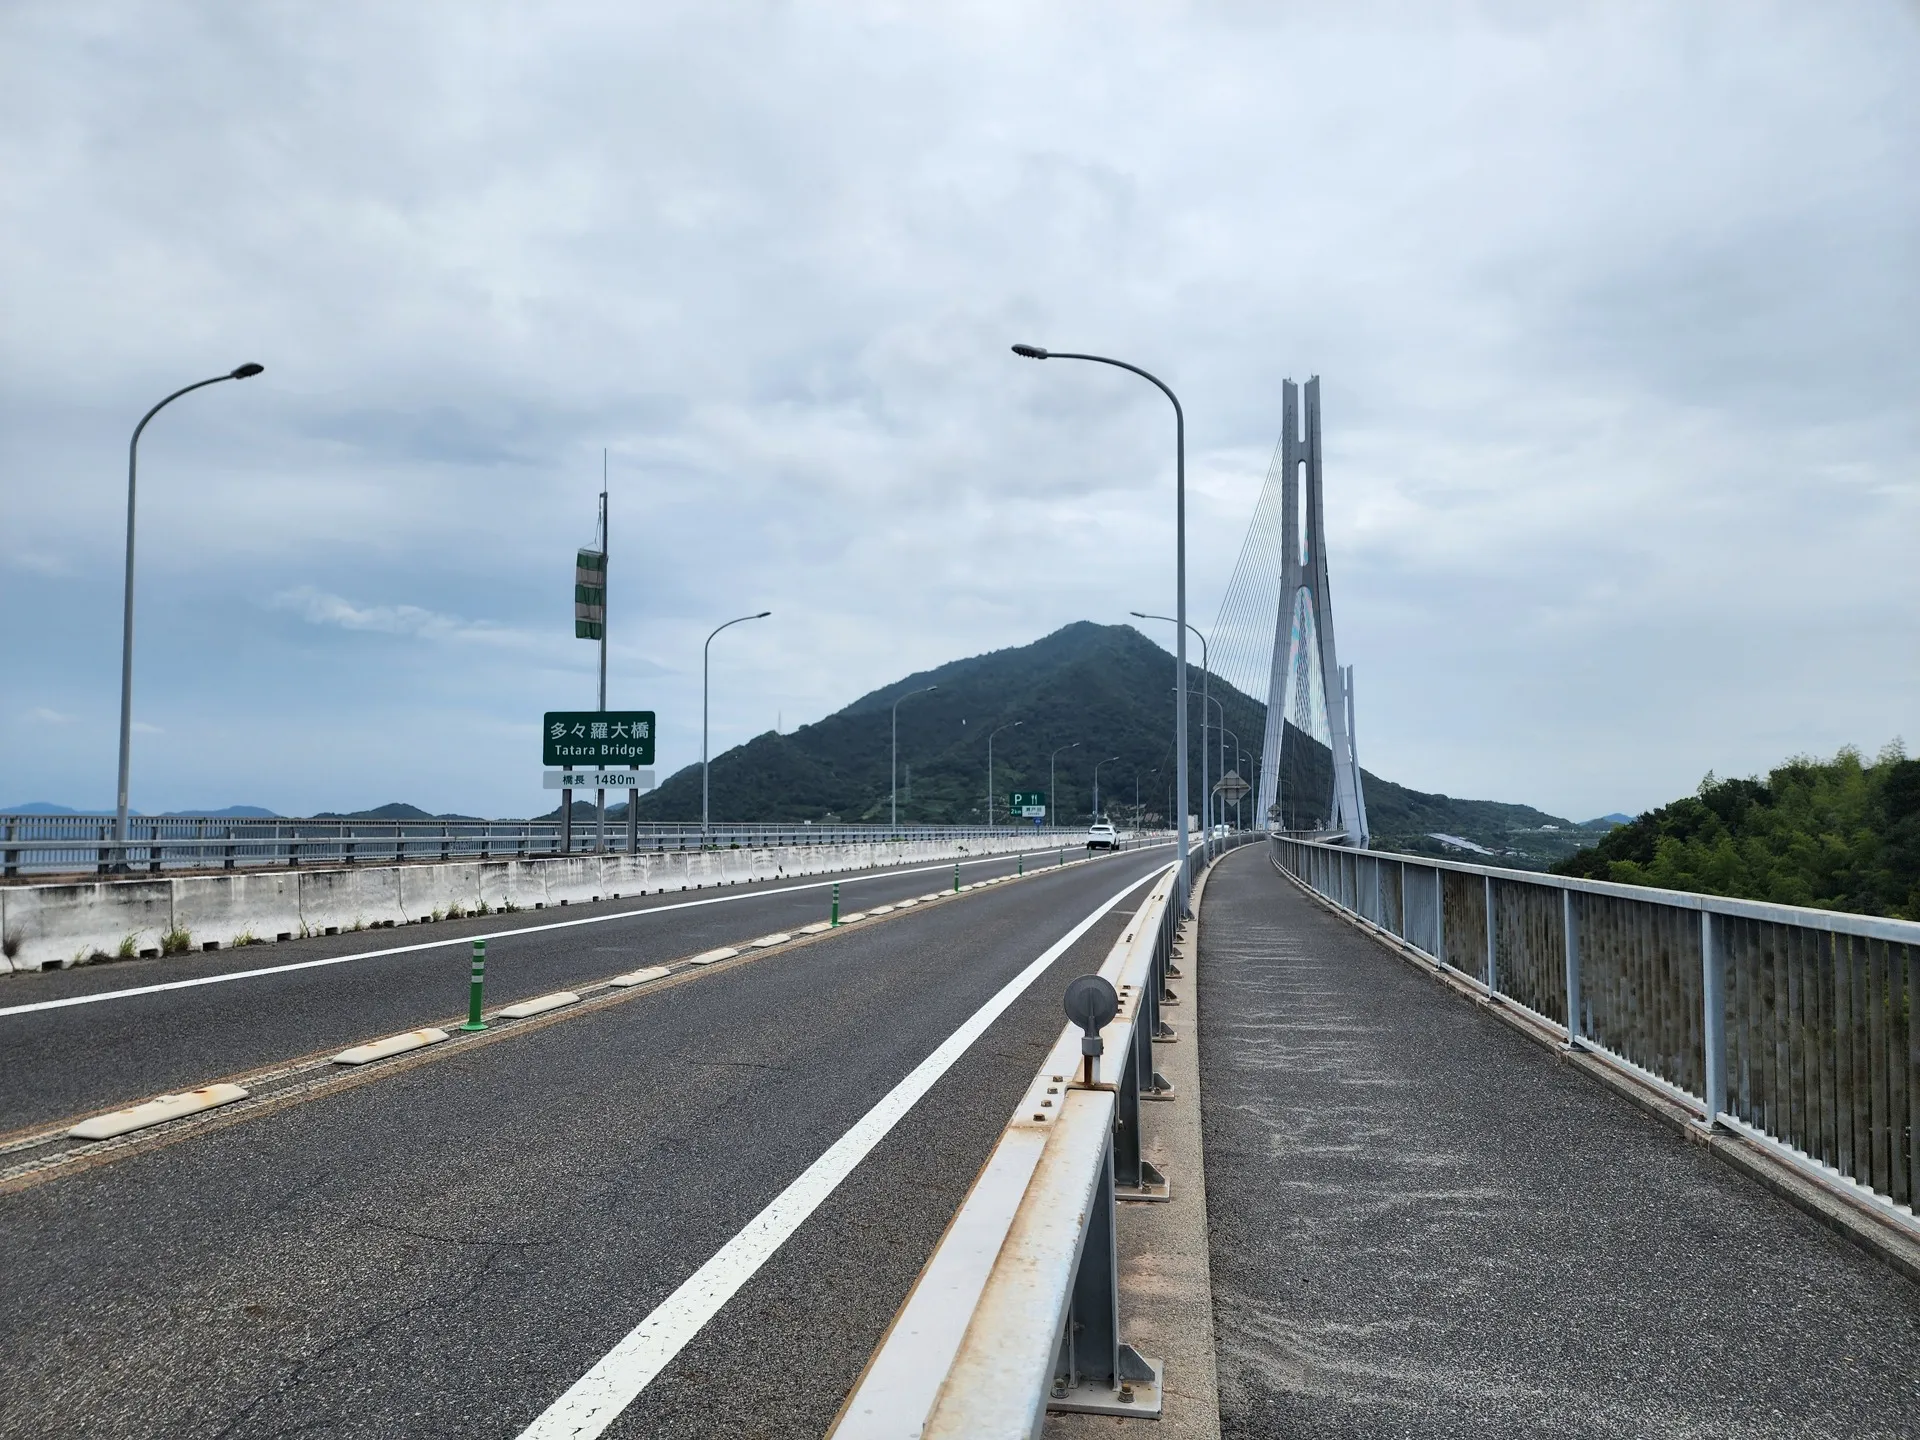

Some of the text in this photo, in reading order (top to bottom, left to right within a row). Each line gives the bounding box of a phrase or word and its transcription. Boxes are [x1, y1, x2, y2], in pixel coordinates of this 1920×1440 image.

[550, 721, 649, 740] 多々羅大橋
[555, 744, 643, 757] Tatara Bridge
[562, 774, 636, 785] 橋長 1480m
[1014, 793, 1023, 805] P
